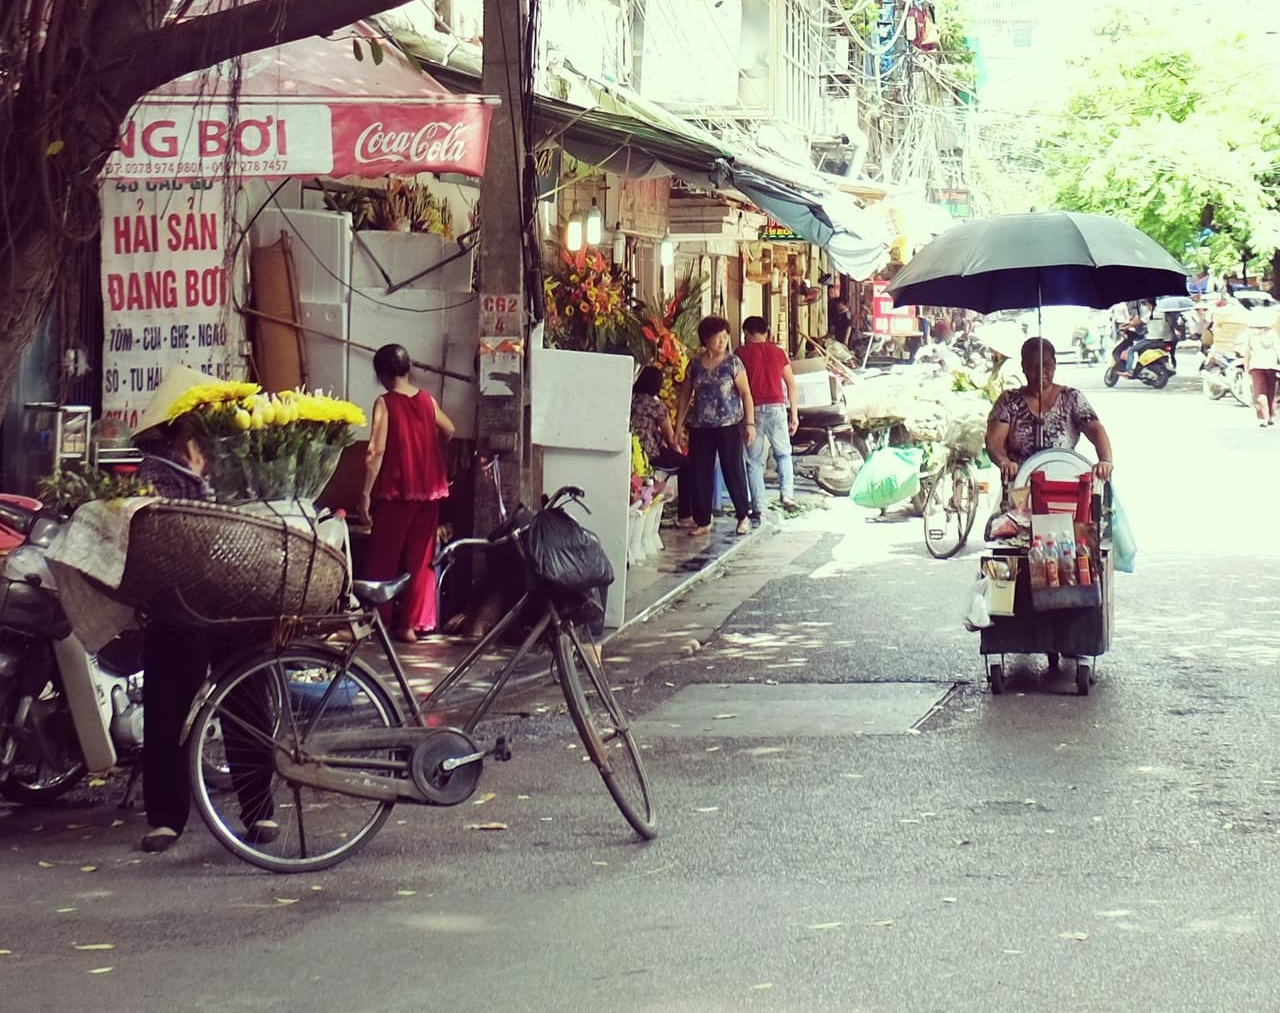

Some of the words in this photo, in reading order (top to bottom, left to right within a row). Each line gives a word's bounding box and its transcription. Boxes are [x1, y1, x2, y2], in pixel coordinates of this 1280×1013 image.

[198, 114, 288, 158] BƠI
[354, 121, 475, 164] Coca-Cola
[263, 160, 288, 172] 7457
[113, 198, 158, 255] HẢI
[166, 196, 217, 252] SẢN
[108, 269, 178, 312] ĐANG
[130, 367, 144, 392] TU
